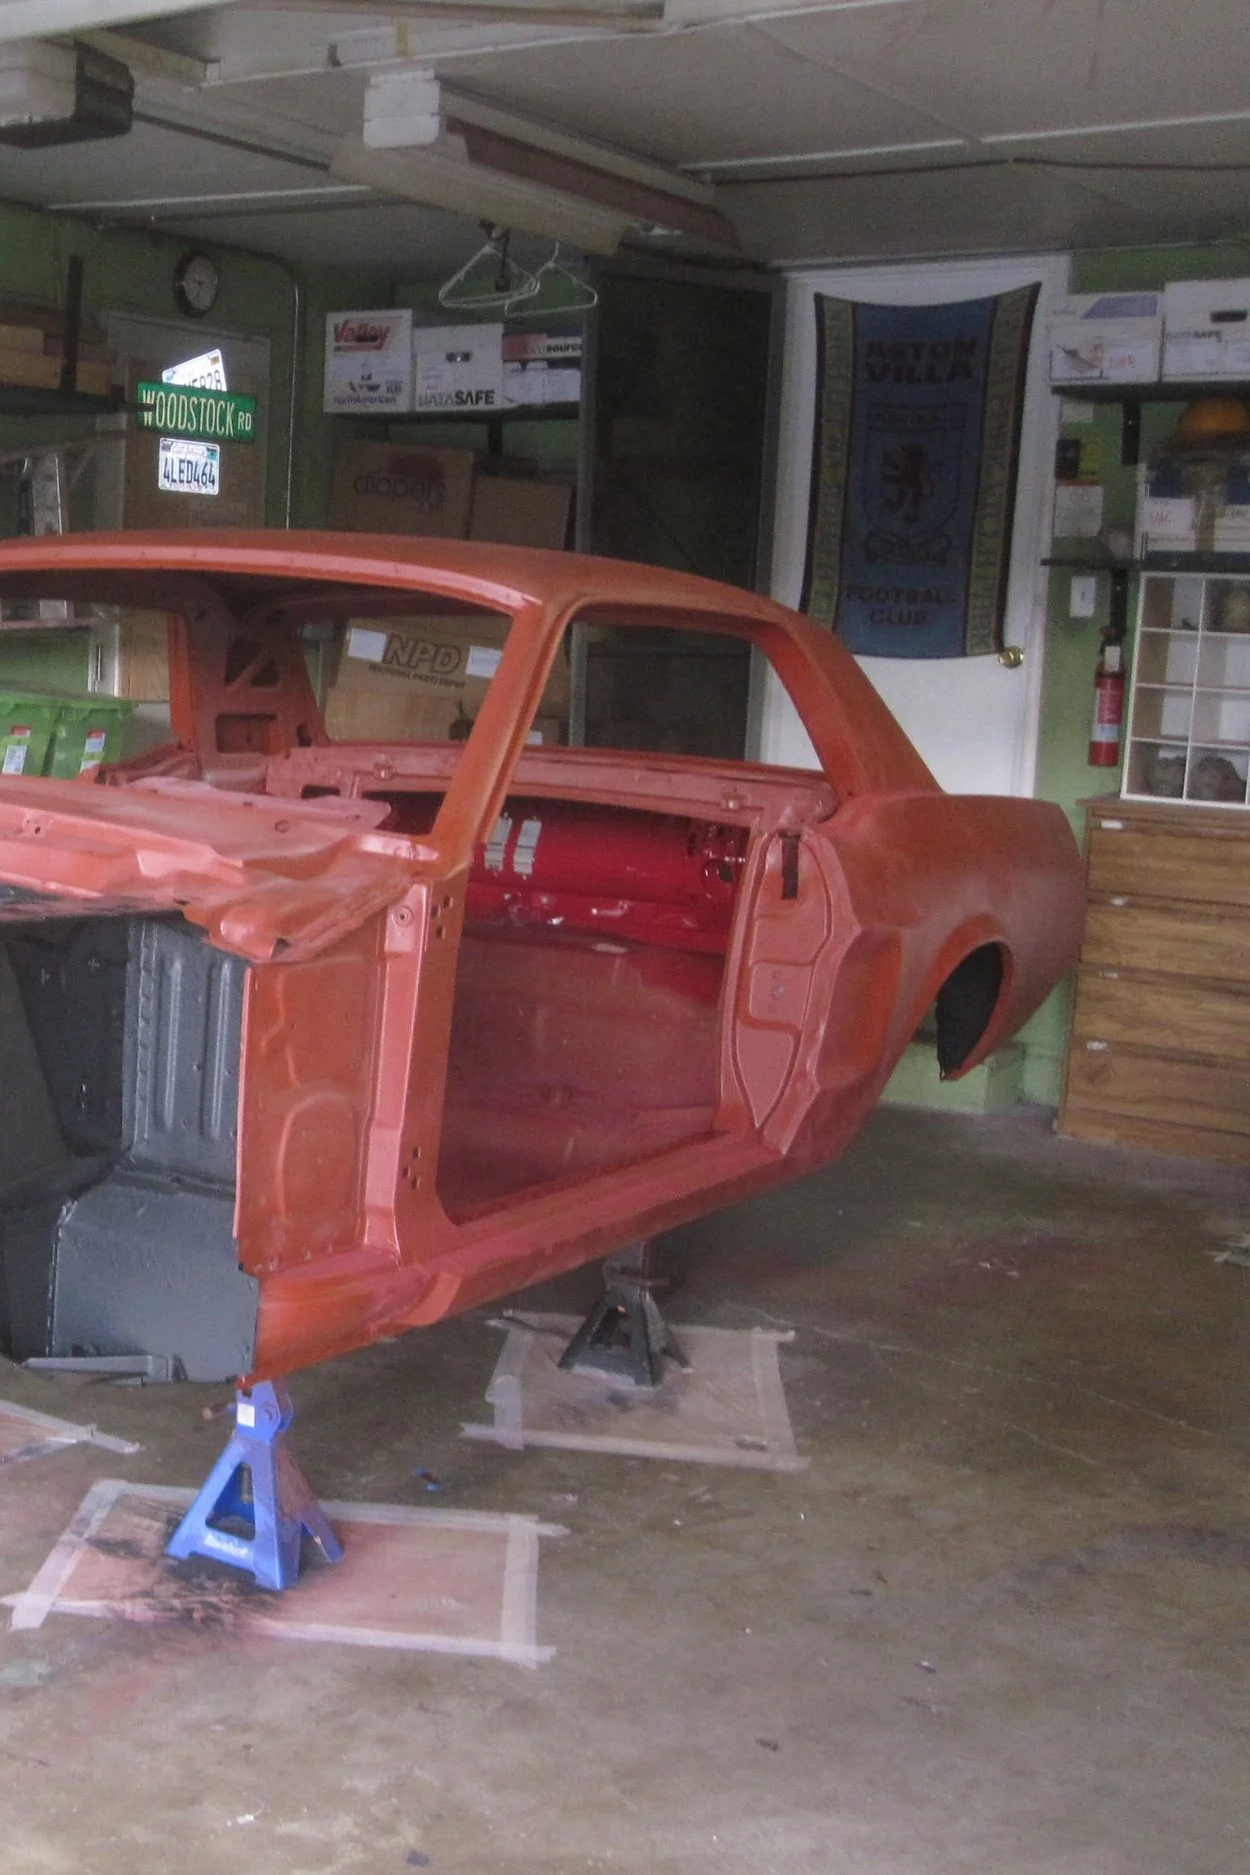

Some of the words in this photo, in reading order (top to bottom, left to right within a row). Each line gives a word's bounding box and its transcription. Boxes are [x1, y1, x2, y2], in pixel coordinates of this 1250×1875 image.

[865, 336, 978, 362] ASTON
[865, 361, 973, 383] VILLA
[418, 389, 496, 407] DATASAFE
[143, 390, 235, 437] WOODSTOCK
[237, 411, 253, 431] RD
[163, 457, 216, 487] 4LED464
[846, 584, 956, 605] FOOTBALL
[869, 607, 929, 627] CLUB
[382, 633, 461, 674] NPD
